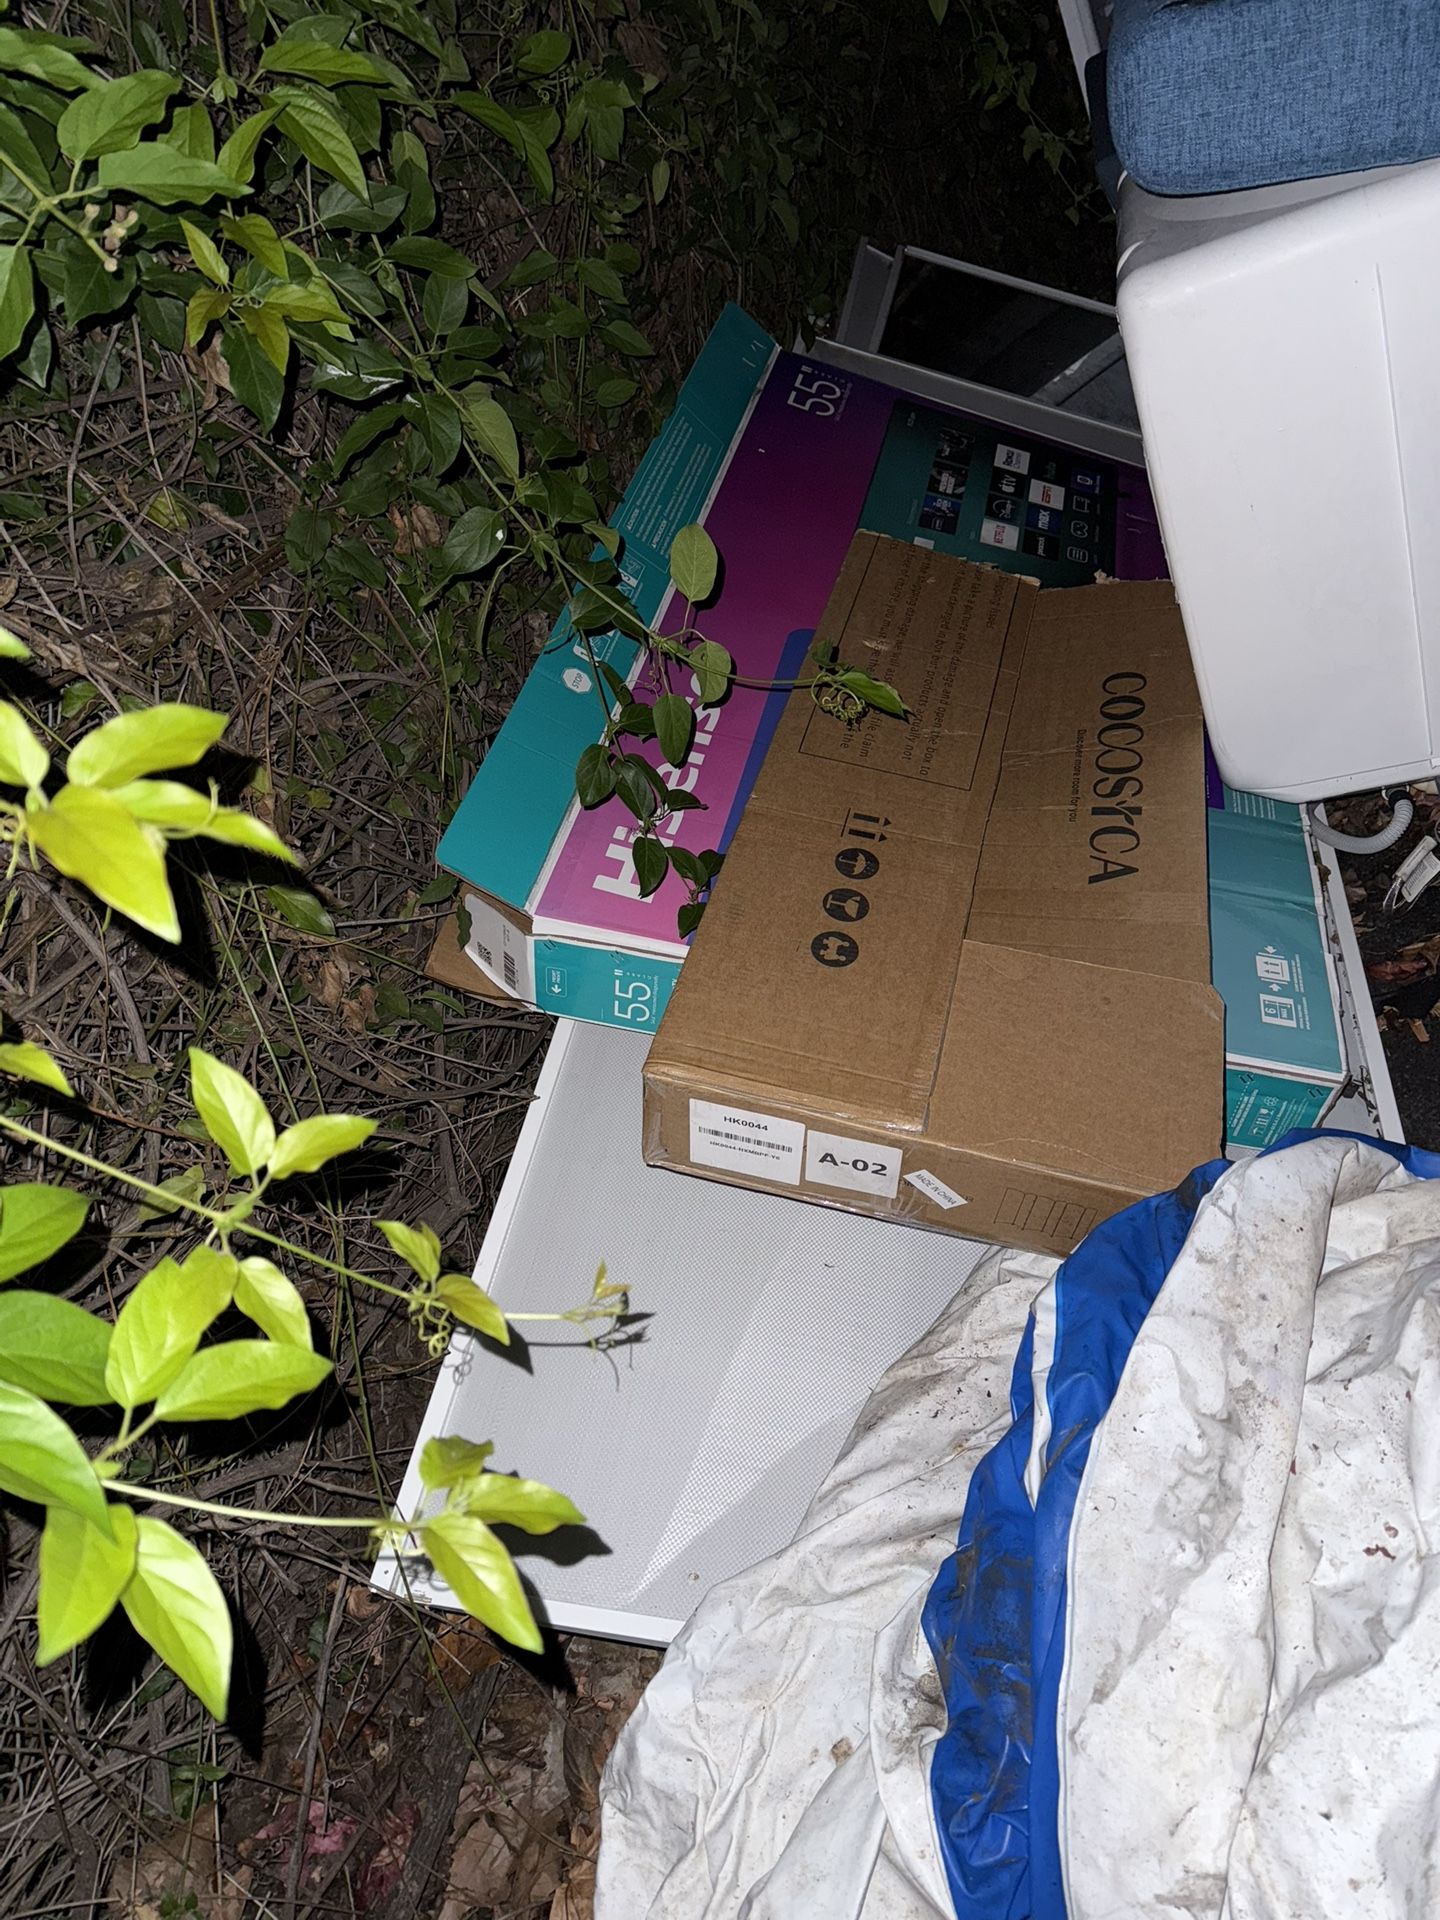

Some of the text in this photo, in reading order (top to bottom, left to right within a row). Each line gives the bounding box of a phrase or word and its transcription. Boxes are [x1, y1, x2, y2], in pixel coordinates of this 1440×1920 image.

[937, 594, 958, 630] damaged
[955, 632, 967, 642] of
[952, 641, 965, 654] the
[941, 654, 962, 687] damage
[572, 673, 584, 688] STOP
[916, 669, 935, 706] products
[938, 688, 952, 705] and
[866, 716, 882, 733] file
[904, 708, 925, 743] actually
[931, 705, 946, 728] open
[839, 732, 853, 749] the
[858, 733, 876, 758] claim
[927, 730, 942, 745] the
[901, 744, 915, 761] not
[922, 746, 937, 764] box
[918, 766, 930, 776] to
[1068, 729, 1087, 822] Discover more room for you
[614, 968, 652, 1022] 55"
[723, 1116, 769, 1131] HK0044
[818, 1152, 888, 1177] A-02
[915, 1174, 936, 1187] MADE
[937, 1191, 958, 1205] CHINA
